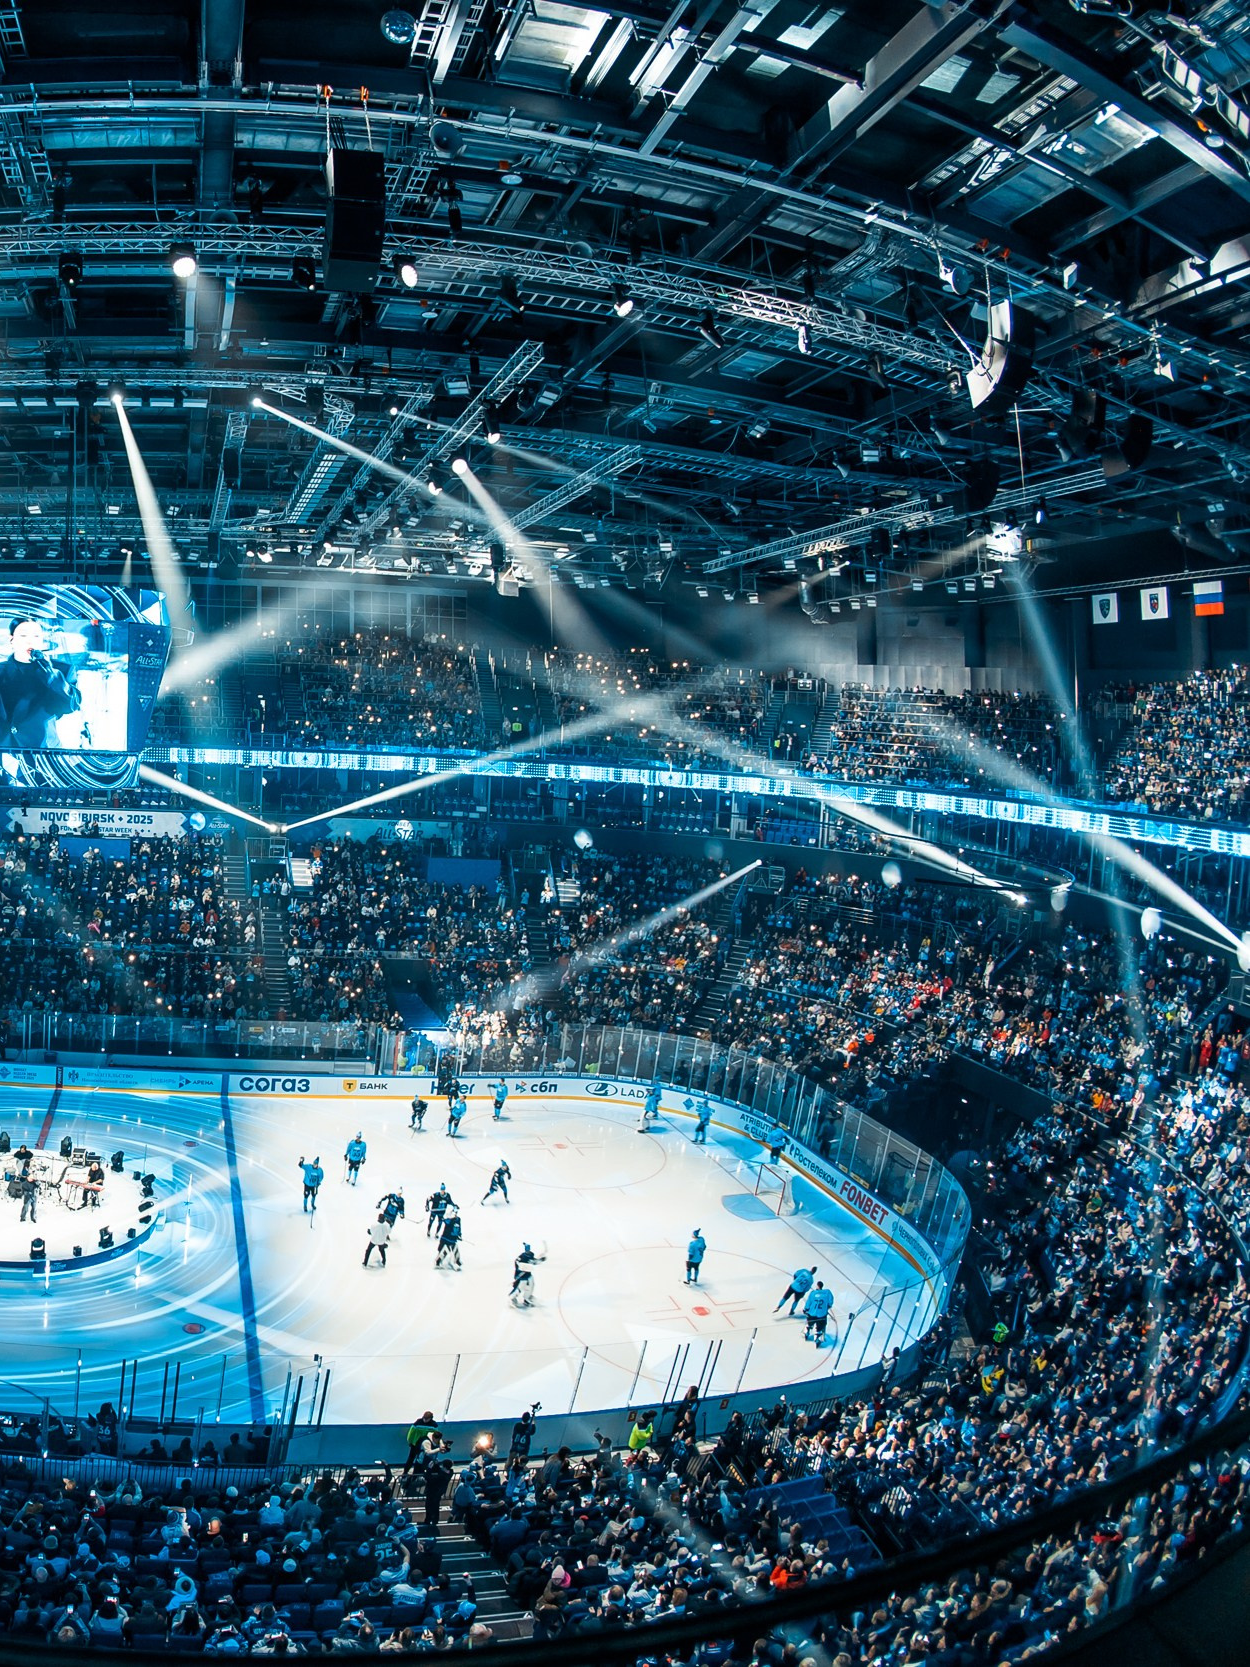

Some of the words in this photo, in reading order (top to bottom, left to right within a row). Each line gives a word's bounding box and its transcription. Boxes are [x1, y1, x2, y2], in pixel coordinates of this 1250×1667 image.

[40, 812, 115, 823] NOVOSIBIRSK
[126, 814, 153, 824] 2025
[359, 1082, 389, 1090] БАНК
[430, 1081, 476, 1094] Her
[531, 1082, 558, 1093] сбп
[750, 1126, 768, 1140] CLUB
[793, 1147, 838, 1188] Ростелеком
[839, 1180, 889, 1225] FONBET
[814, 1299, 824, 1309] 72
